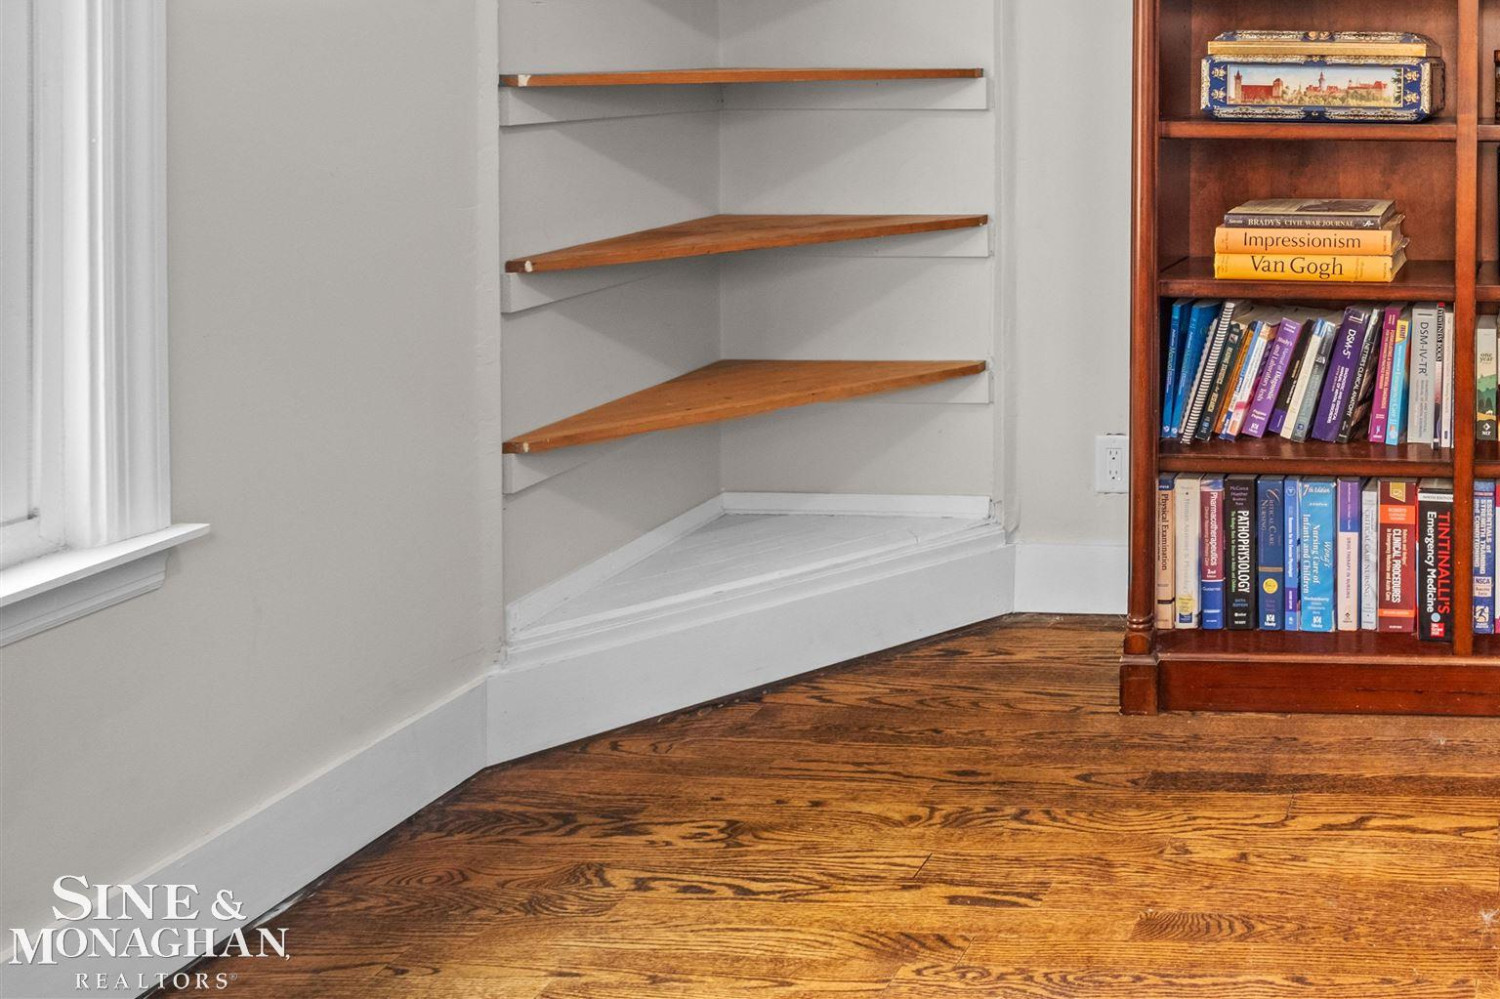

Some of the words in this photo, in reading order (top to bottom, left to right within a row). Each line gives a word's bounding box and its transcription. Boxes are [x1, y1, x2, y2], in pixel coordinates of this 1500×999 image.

[1248, 218, 1281, 226] BRADY'S
[1243, 232, 1361, 251] Impressionism
[1251, 255, 1285, 273] Van
[1290, 257, 1343, 279] Gogh
[1418, 321, 1429, 376] DSM-IV-TR
[1160, 494, 1169, 522] Physical
[1209, 492, 1218, 566] Pharmacotherapeutics
[1302, 514, 1311, 542] Infants
[1311, 524, 1320, 555] Nursing
[1392, 528, 1401, 558] CLINICAL
[1424, 511, 1436, 566] Emergency
[1161, 524, 1169, 571] Examination
[1237, 510, 1250, 593] PATHOPHYSIOLOGY
[1302, 544, 1311, 558] and
[1437, 512, 1450, 614] TINTINALLI'S
[1303, 560, 1311, 594] Children
[1312, 557, 1320, 574] Care
[1312, 575, 1320, 584] of
[1392, 559, 1401, 603] PROCEDURES
[1426, 568, 1436, 613] Medicine
